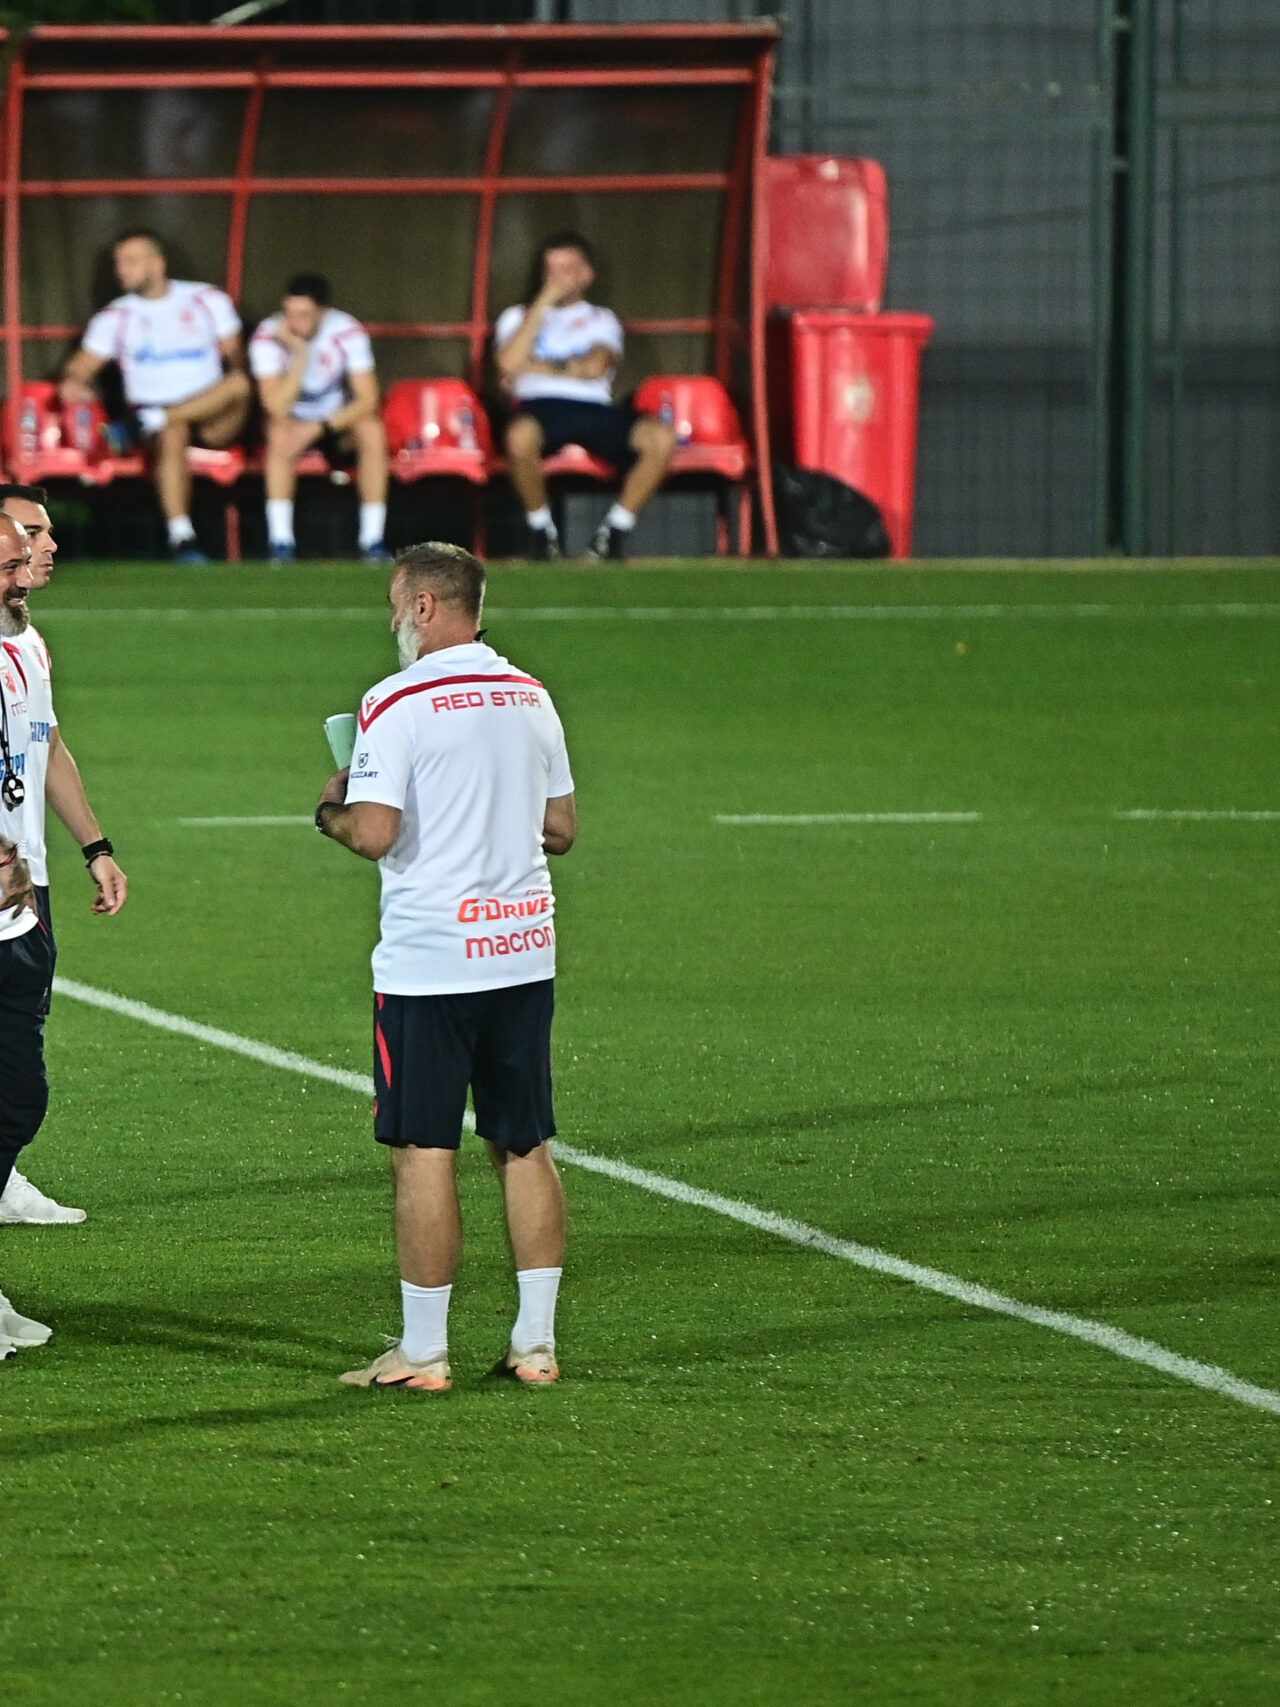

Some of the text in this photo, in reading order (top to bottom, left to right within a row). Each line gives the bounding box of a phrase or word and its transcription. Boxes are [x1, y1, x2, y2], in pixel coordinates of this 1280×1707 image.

[431, 690, 542, 714] RED STAR
[465, 926, 555, 959] macron
